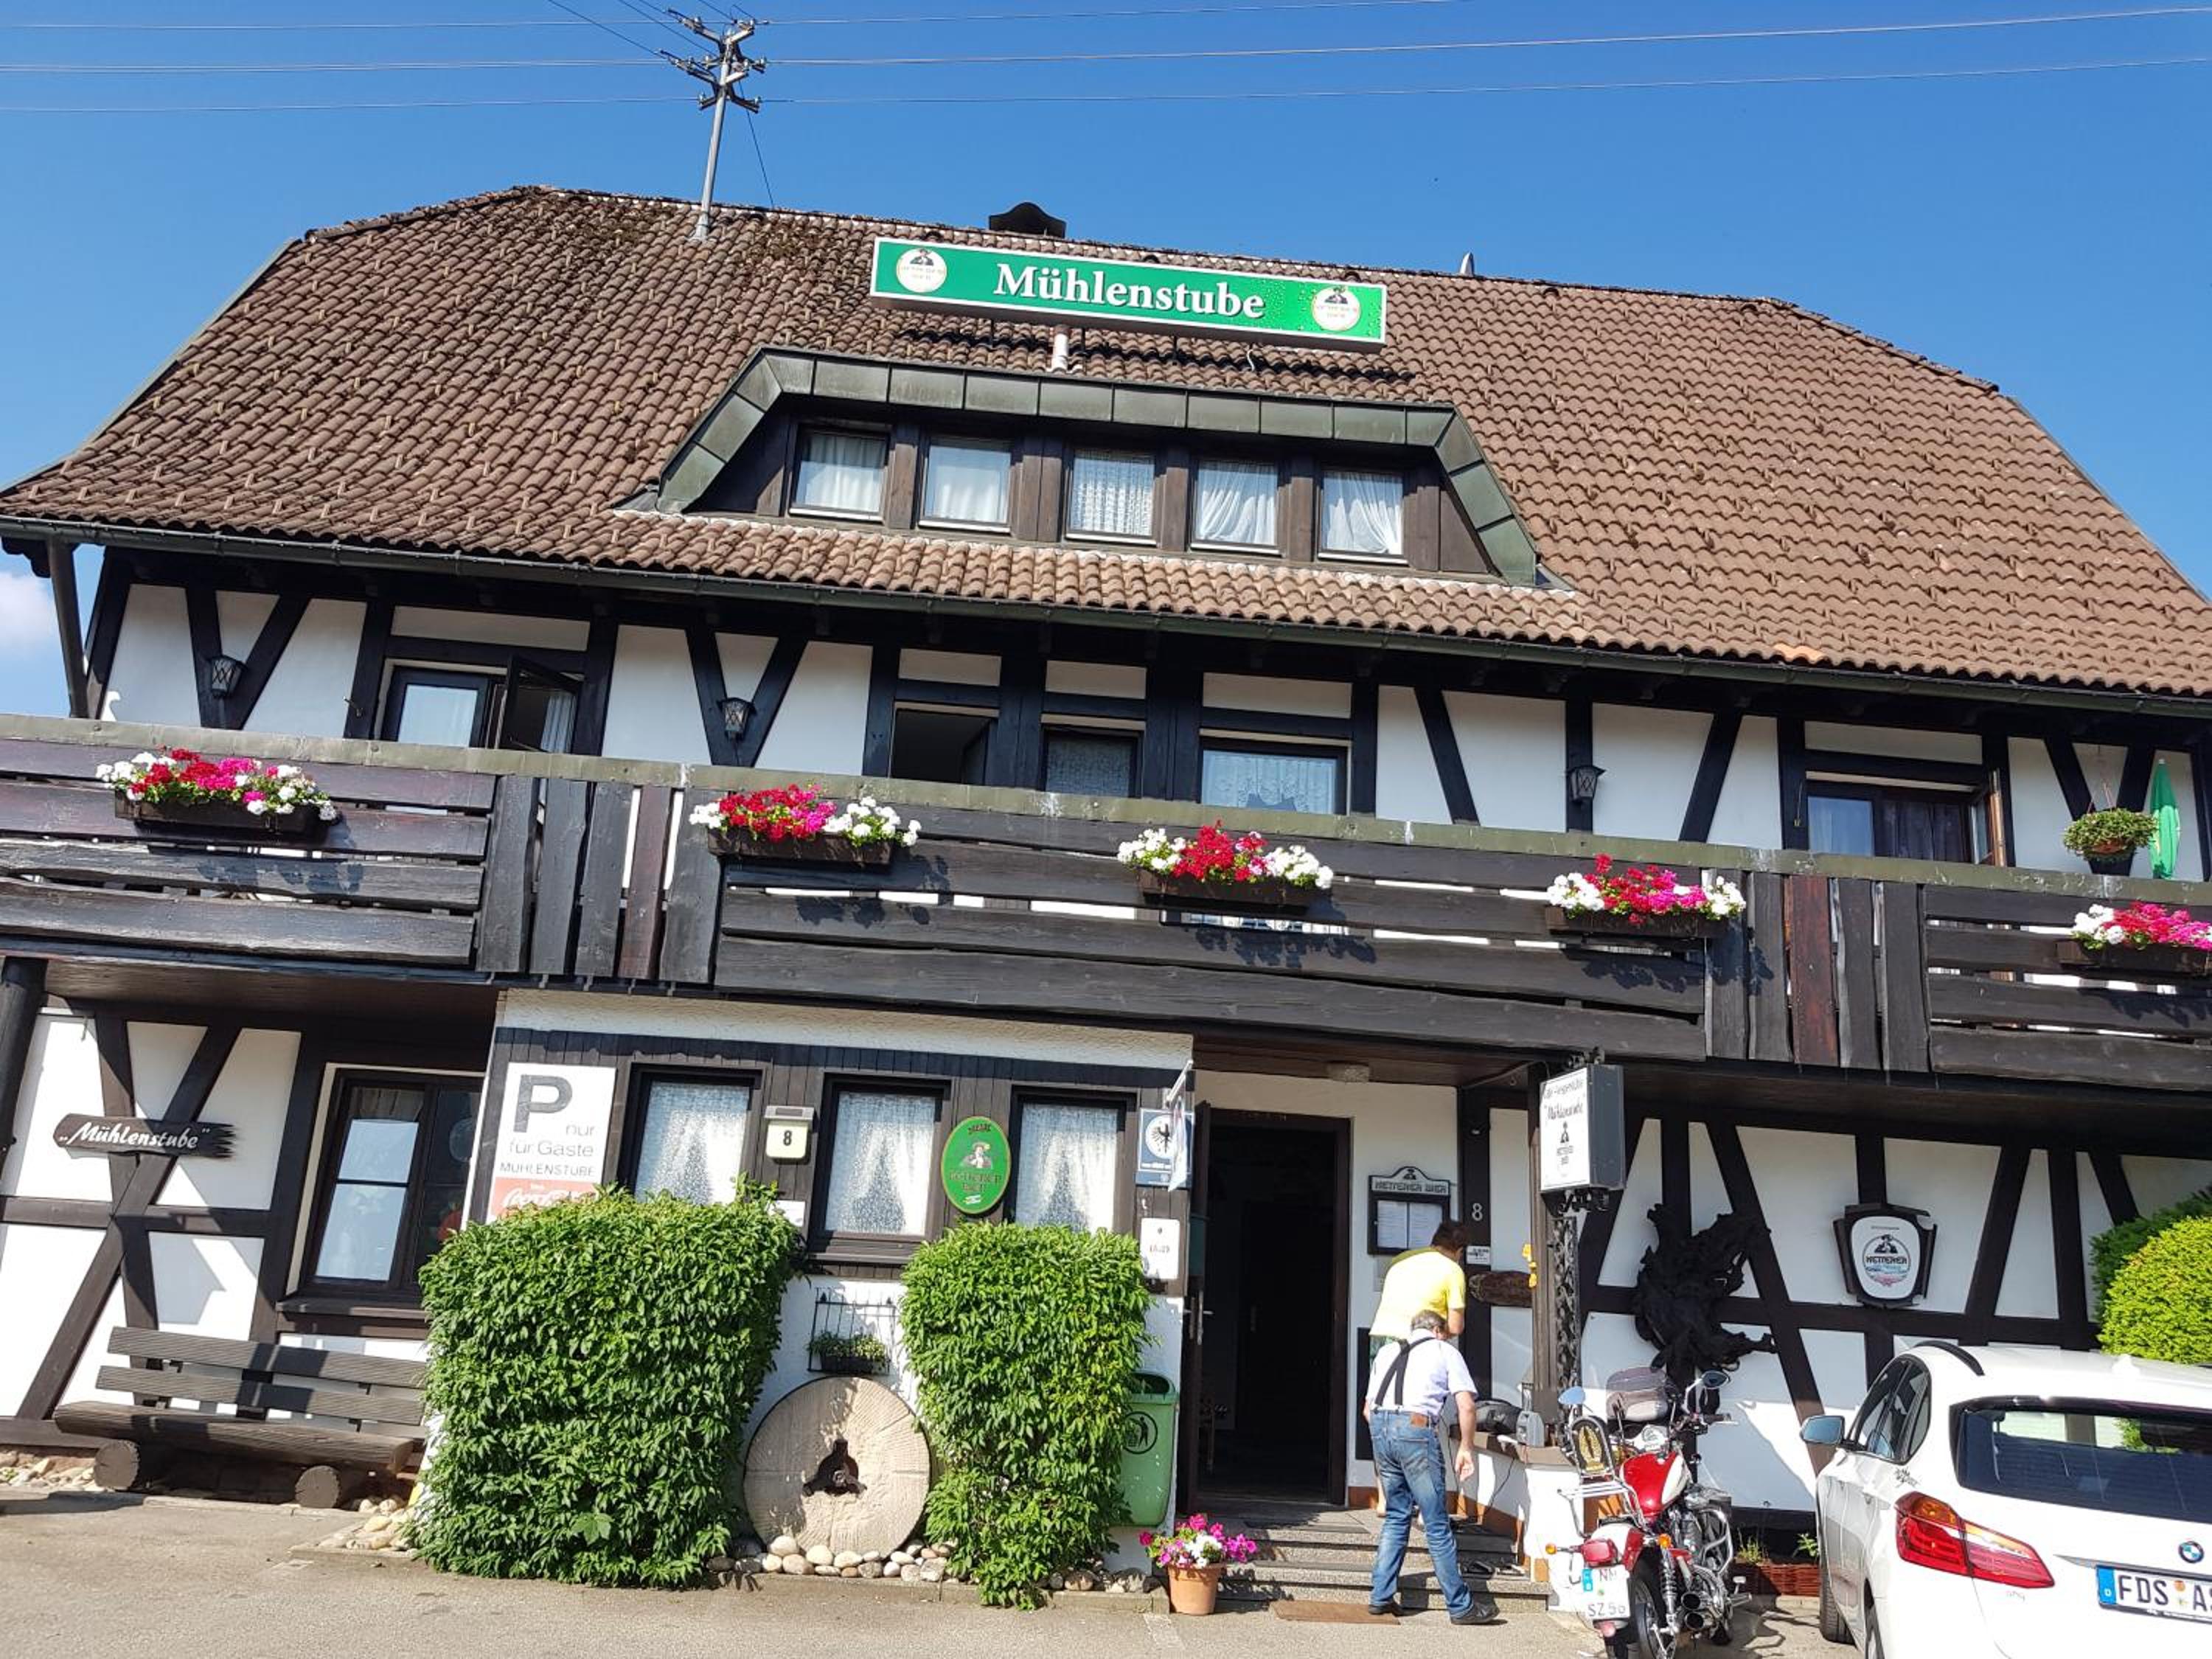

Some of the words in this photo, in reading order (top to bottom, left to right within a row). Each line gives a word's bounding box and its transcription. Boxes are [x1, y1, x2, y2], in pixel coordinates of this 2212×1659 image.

[994, 262, 1265, 319] Mühlenstube
[513, 1074, 572, 1133] P
[566, 1123, 596, 1136] nur
[783, 1130, 793, 1146] 8
[1472, 1203, 1483, 1221] 8
[2118, 1574, 2168, 1606] FDS
[2194, 1585, 2212, 1612] A
